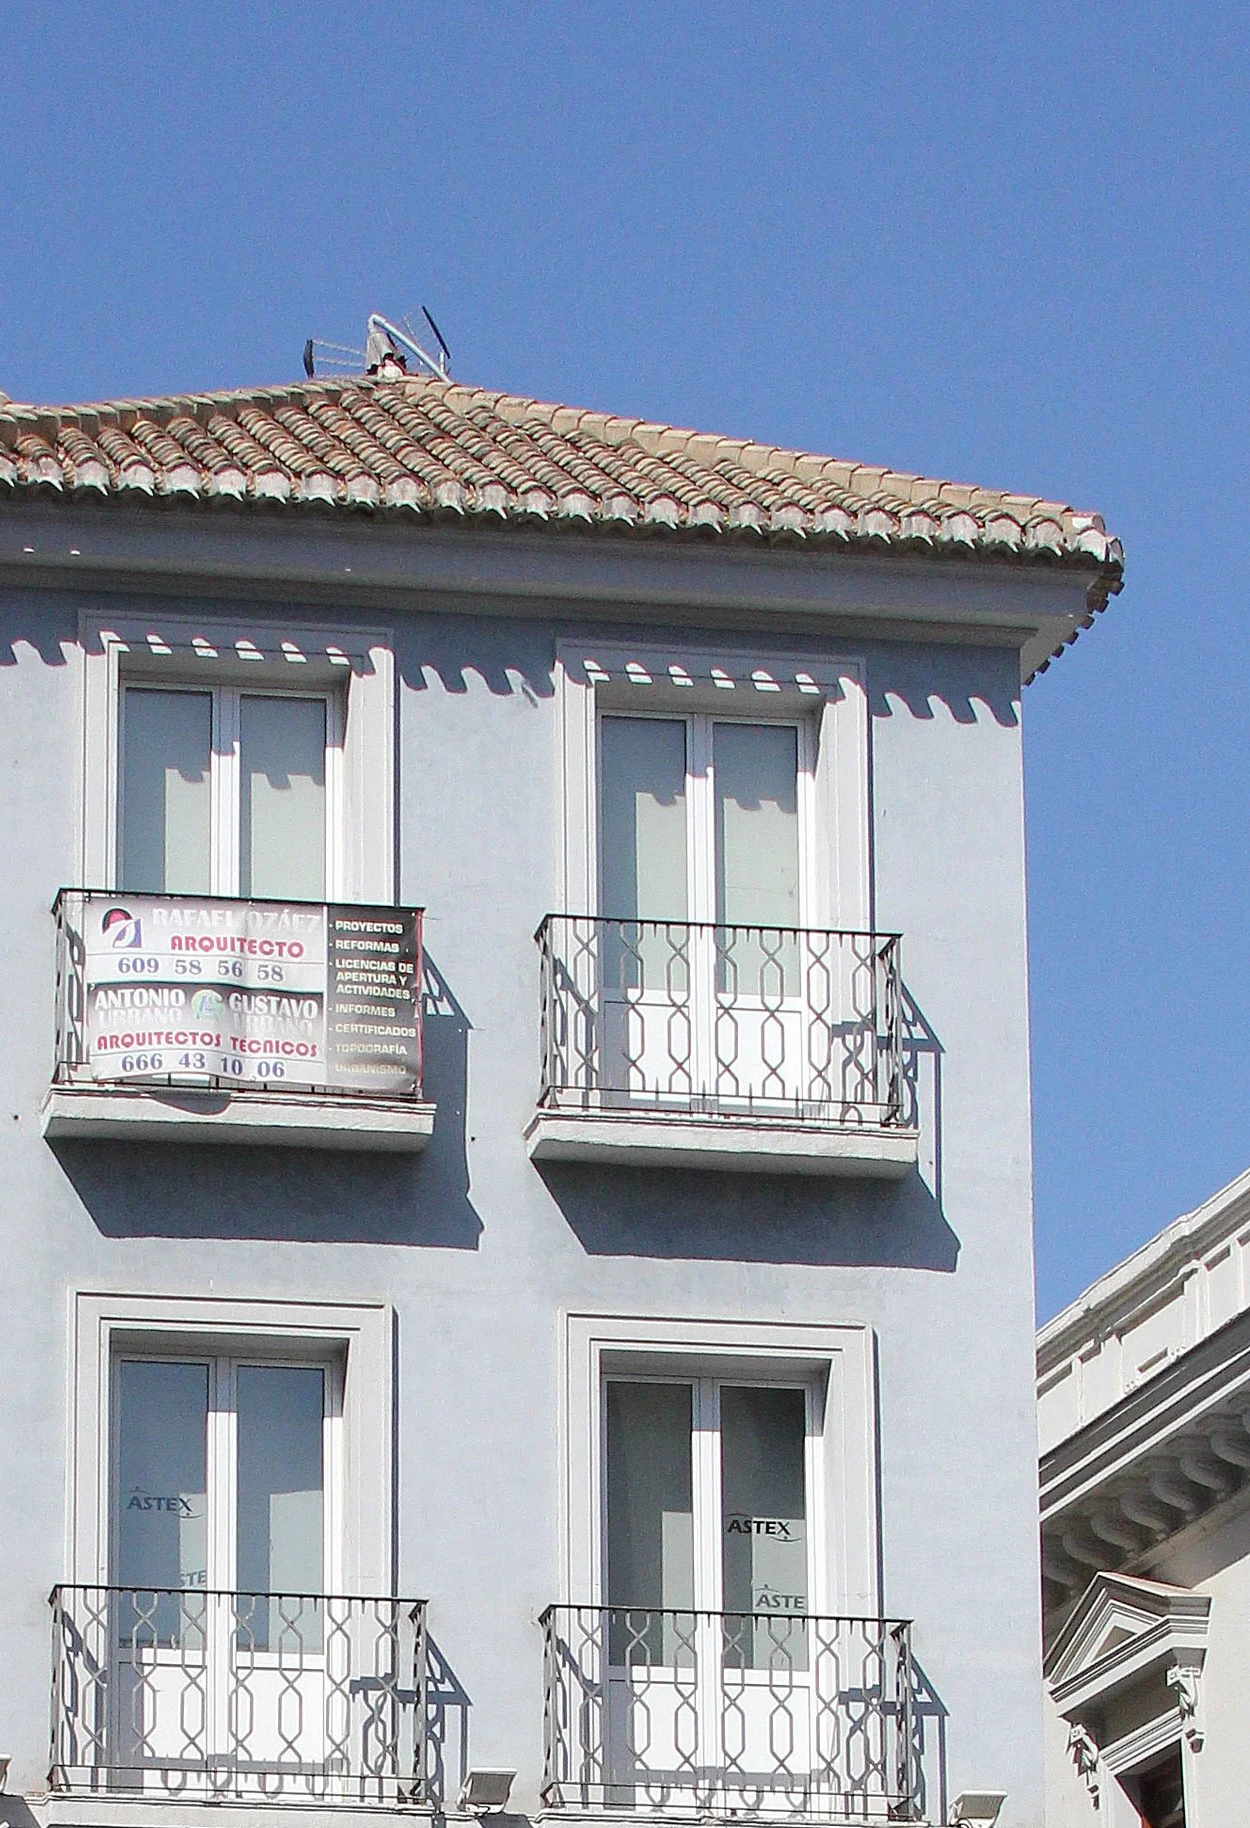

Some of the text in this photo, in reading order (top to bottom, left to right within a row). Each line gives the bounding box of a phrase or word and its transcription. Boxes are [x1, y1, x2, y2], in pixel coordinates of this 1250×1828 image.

[151, 908, 237, 928] RAFAEL
[335, 920, 403, 934] PROYECTOS
[171, 935, 304, 958] ARQUITECTO
[335, 939, 399, 953] REFORMAS
[118, 957, 284, 981] 609 58 56 58
[335, 958, 414, 974] LICENCIAS DE
[336, 971, 408, 986] APERTURA Y
[95, 988, 185, 1010] ANTONIO
[336, 983, 410, 1000] ACTIVIDADES
[229, 993, 319, 1019] GUSTAVO
[335, 1003, 396, 1018] INFORMES
[335, 1023, 416, 1038] CERTIFICADOS
[97, 1031, 318, 1058] ARQUITECTOS TÉCNICOS
[335, 1043, 408, 1056] TOPOGRAFÍA
[121, 1052, 285, 1078] 666 43 10 06
[334, 1063, 407, 1075] URBANISMO
[127, 1496, 193, 1512] ASTEX
[727, 1519, 791, 1536] ASTEX
